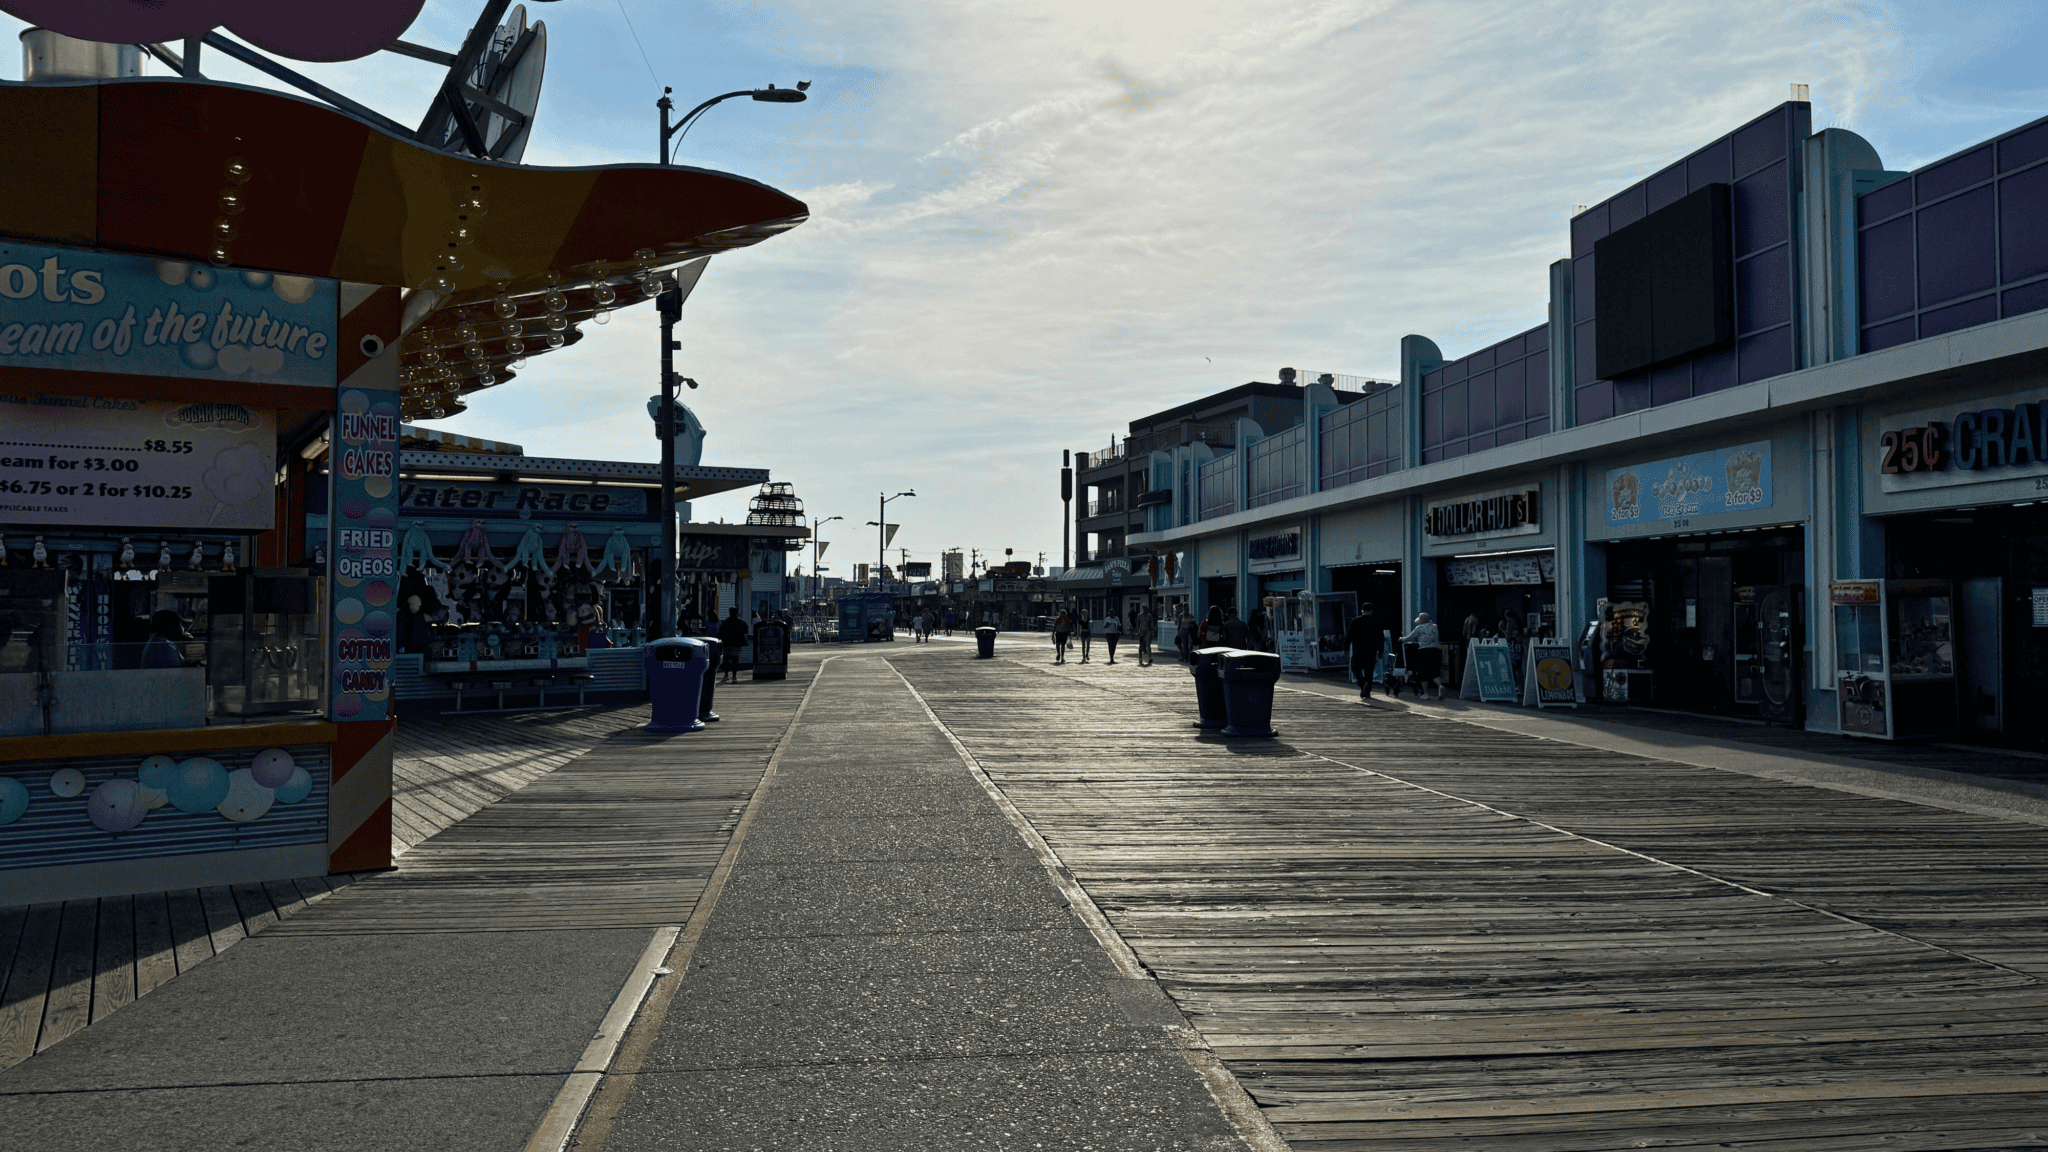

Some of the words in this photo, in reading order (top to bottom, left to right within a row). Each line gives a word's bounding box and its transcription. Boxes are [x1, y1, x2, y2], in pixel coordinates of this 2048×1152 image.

[92, 302, 137, 356] of
[144, 301, 207, 345] the
[212, 301, 328, 359] future
[178, 403, 214, 424] SUGAR
[215, 403, 249, 426] SHACK
[342, 412, 396, 442] FUNNEL
[144, 439, 193, 454] $8.55
[1881, 421, 1940, 475] 25¢
[48, 455, 79, 470] for
[84, 458, 139, 472] $3.00
[344, 450, 393, 477] CAKES
[0, 480, 51, 496] $6.75
[56, 485, 78, 496] or
[82, 483, 94, 496] 2
[99, 482, 128, 498] for
[133, 484, 192, 500] $10.25
[516, 488, 611, 511] Race
[1726, 493, 1733, 505] 2
[1733, 492, 1748, 504] for
[1750, 488, 1762, 505] $9
[1438, 500, 1484, 536] DOLLAR
[1488, 495, 1513, 529] HUT
[1612, 509, 1617, 521] 2
[1618, 508, 1629, 518] for
[1629, 505, 1639, 518] $9
[1675, 504, 1699, 515] Cream
[339, 529, 394, 548] FRIED
[339, 558, 394, 578] OREOS
[97, 593, 110, 636] HOOK
[338, 639, 391, 662] COTTON
[664, 661, 684, 669] RECYCLE
[1479, 660, 1493, 677] $1
[341, 670, 387, 692] CANDY
[1540, 687, 1575, 701] LEMONADE
